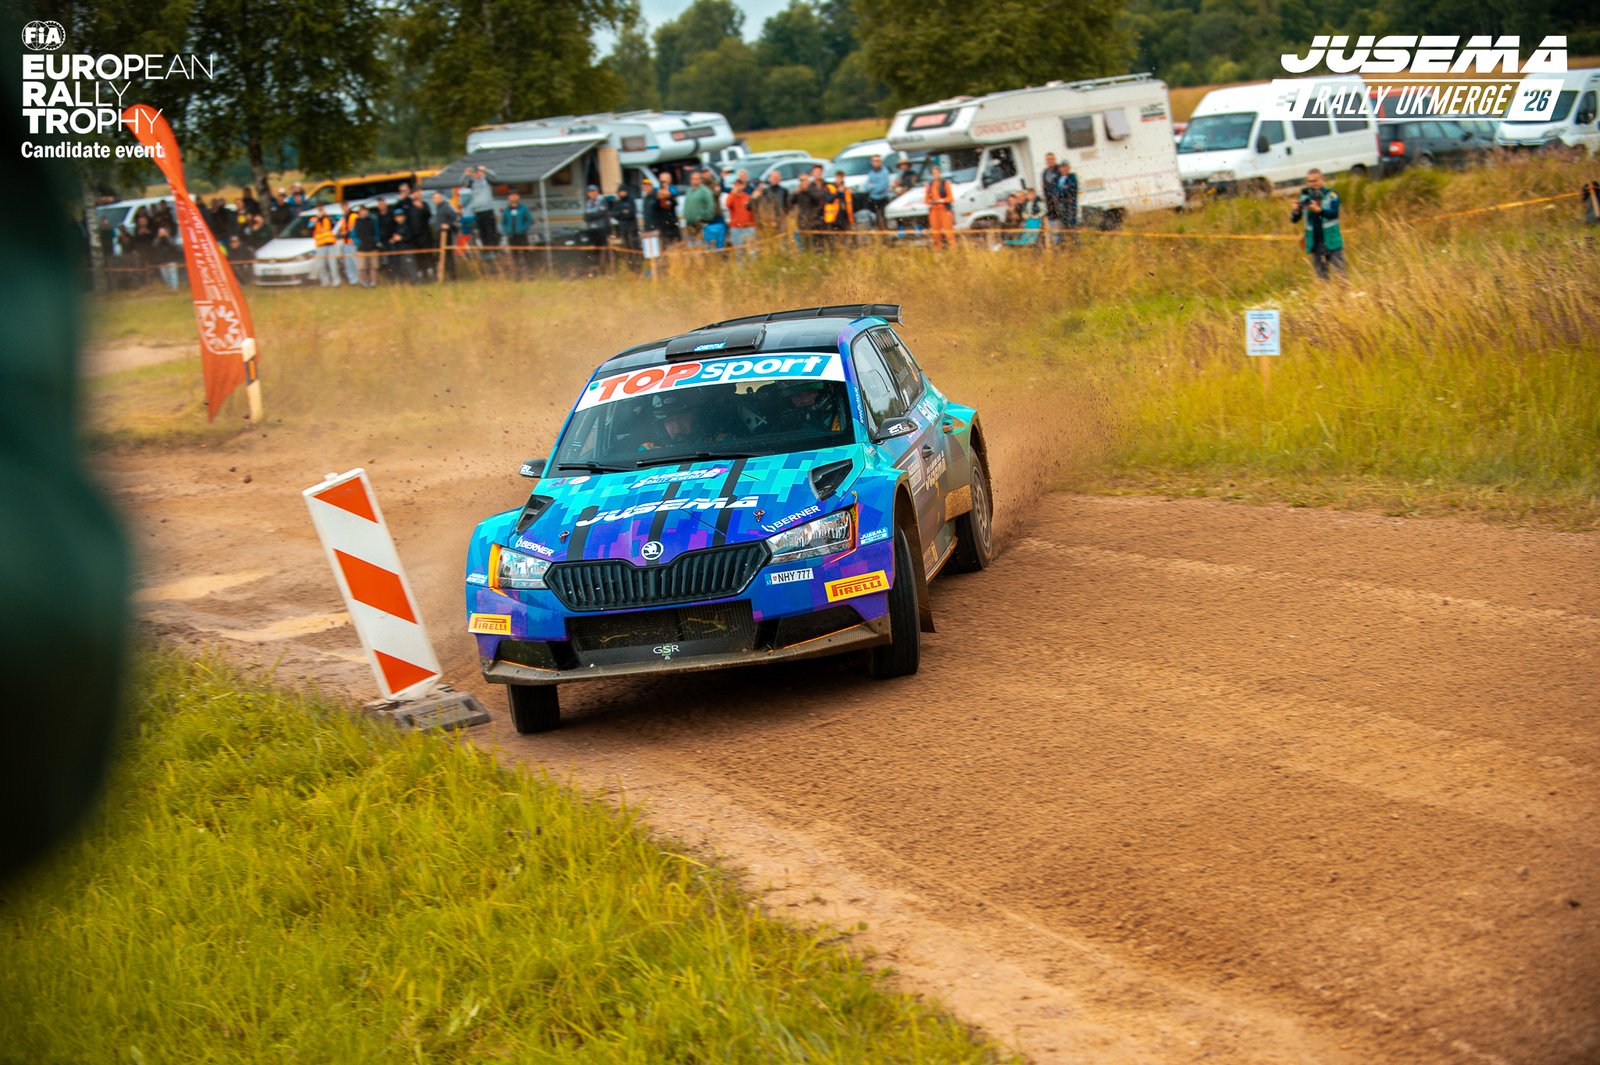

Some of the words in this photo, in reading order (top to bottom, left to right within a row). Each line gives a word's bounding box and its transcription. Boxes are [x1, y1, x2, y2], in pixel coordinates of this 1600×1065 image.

[576, 496, 759, 526] JUSEMA
[773, 505, 821, 528] BERNER
[521, 540, 554, 556] BERNER
[777, 572, 795, 583] NHY
[797, 570, 810, 580] 777
[831, 575, 882, 597] PIRELLI
[473, 617, 507, 631] PIRELLI
[652, 644, 680, 654] GSR
